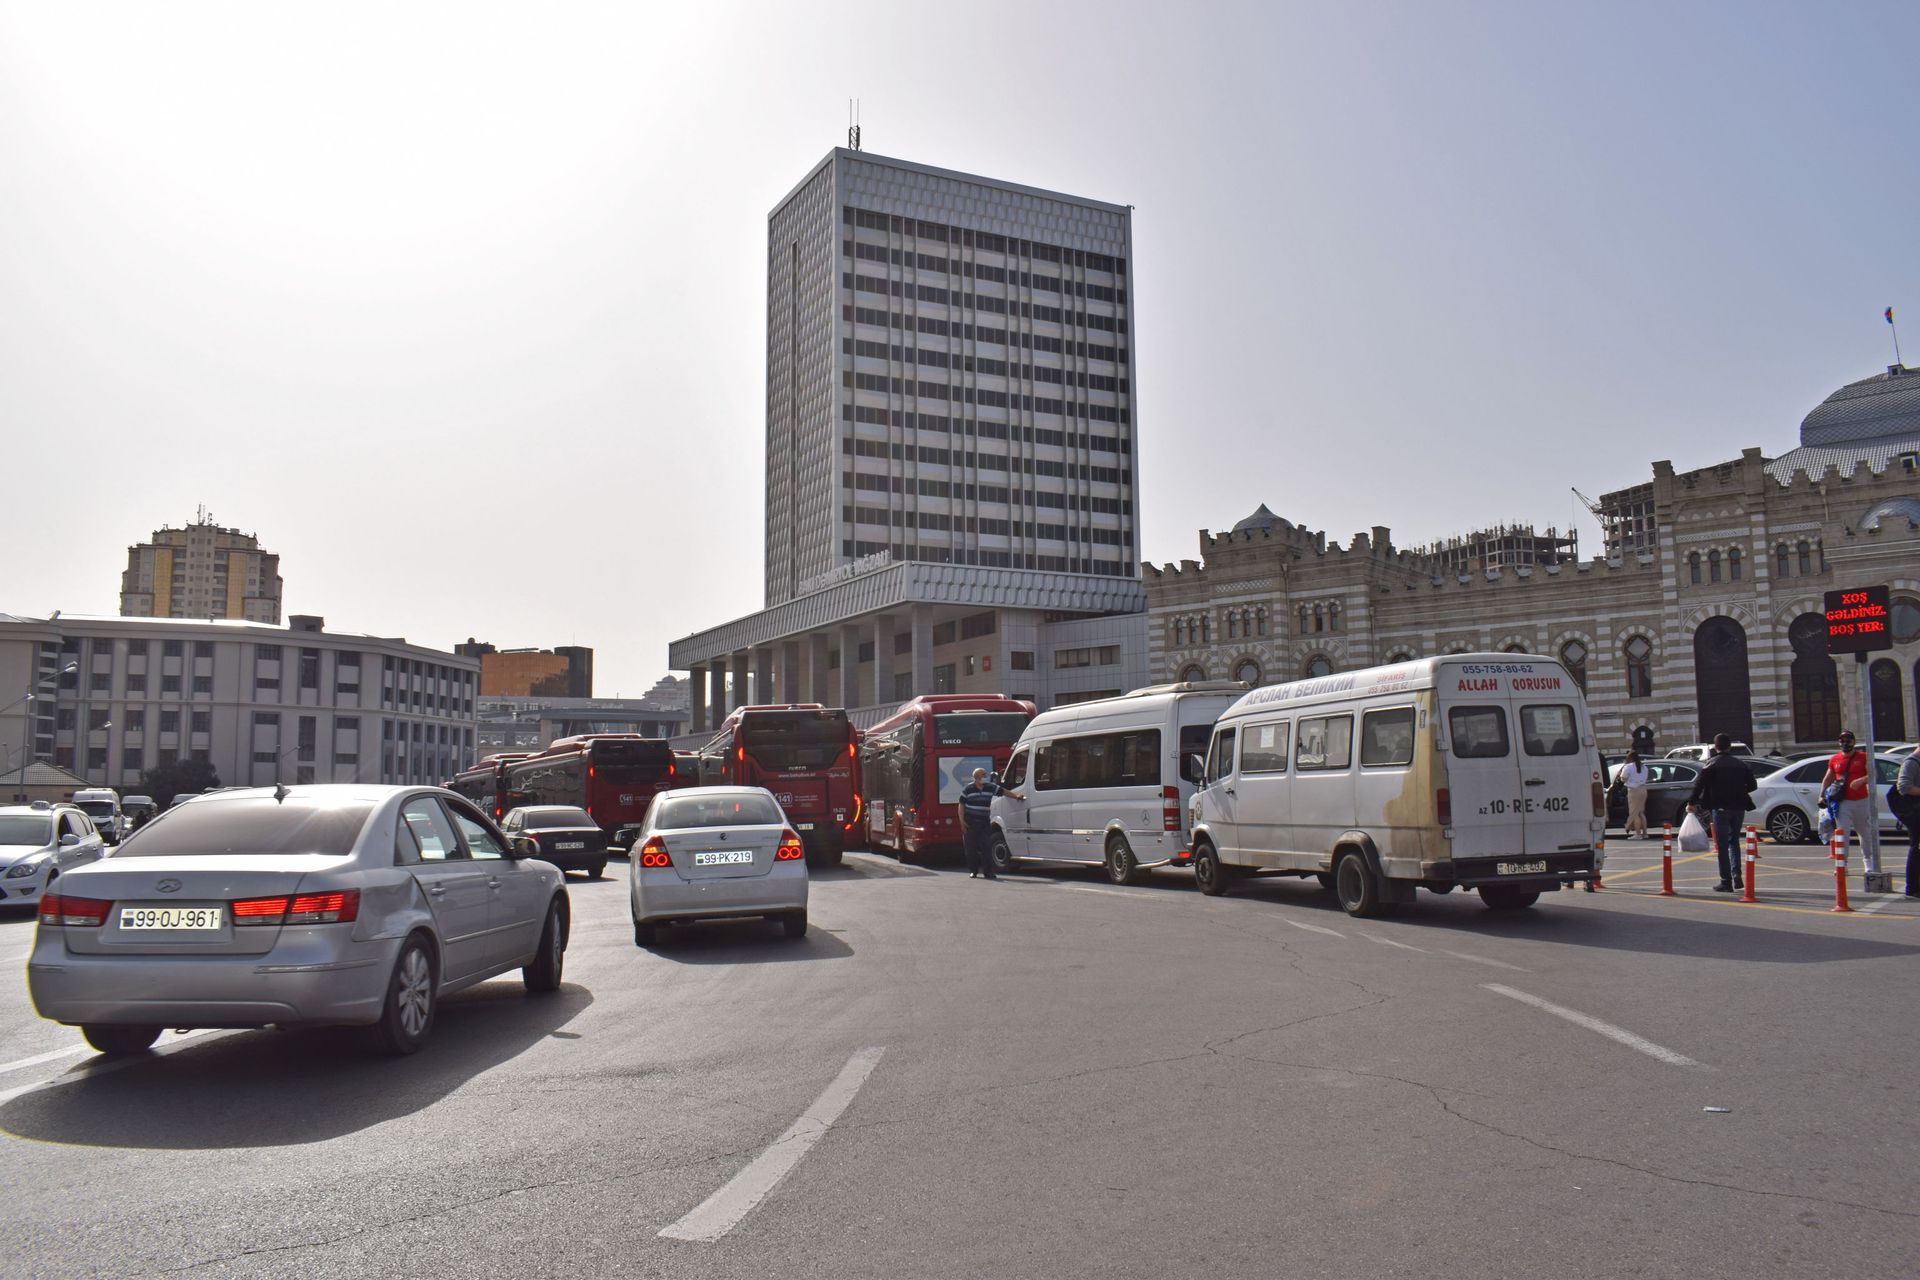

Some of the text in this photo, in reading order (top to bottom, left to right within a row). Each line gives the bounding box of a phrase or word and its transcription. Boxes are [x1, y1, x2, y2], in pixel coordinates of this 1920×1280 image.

[1841, 592, 1868, 605] XOŞ
[1829, 621, 1884, 636] BOŞ YER:
[1462, 665, 1534, 674] 055-758-80-62
[1458, 677, 1560, 691] ALLAH QORUSUN
[1478, 807, 1488, 815] AZ
[704, 852, 752, 864] 99-PK-219
[135, 910, 215, 928] 99-OJ-961
